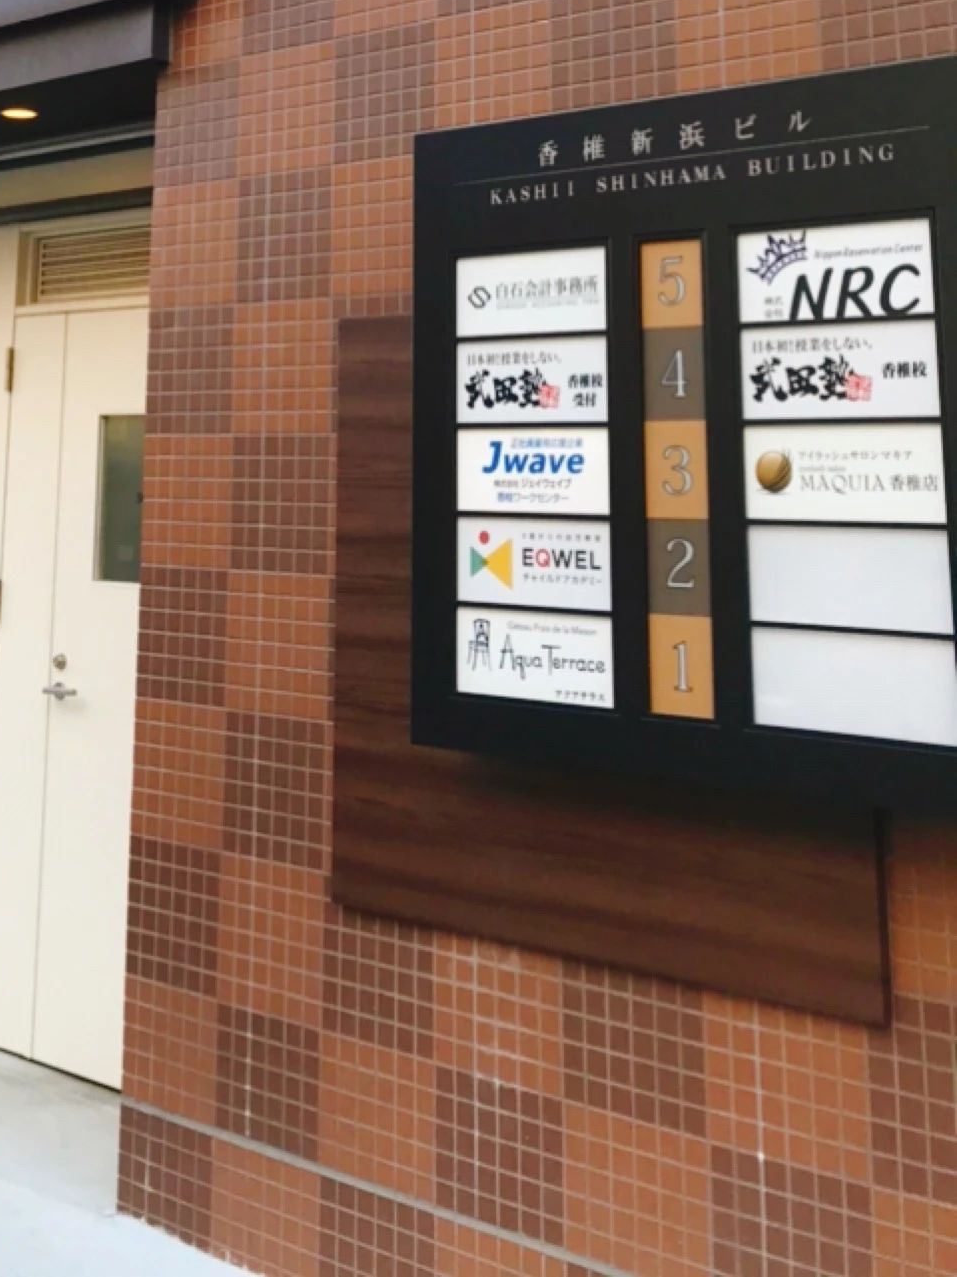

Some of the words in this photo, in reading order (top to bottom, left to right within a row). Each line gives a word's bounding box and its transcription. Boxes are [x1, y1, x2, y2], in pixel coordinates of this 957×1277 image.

[538, 110, 811, 167] 香椎新浜ビル
[490, 180, 575, 205] KASHII
[596, 164, 726, 193] SHINHAMA
[747, 144, 895, 177] BUILDING
[657, 255, 687, 306] 5
[790, 263, 922, 321] NRC
[661, 349, 688, 398] 4
[882, 360, 928, 379] 香椎校
[482, 440, 585, 474] Jwave
[661, 444, 694, 496] 3
[799, 474, 885, 495] MAQUIA
[891, 473, 939, 493] 香椎店
[521, 546, 602, 570] EQWEL
[665, 538, 696, 588] 2
[499, 633, 542, 680] Aqua
[541, 644, 607, 676] Terrace
[672, 640, 694, 693] 1
